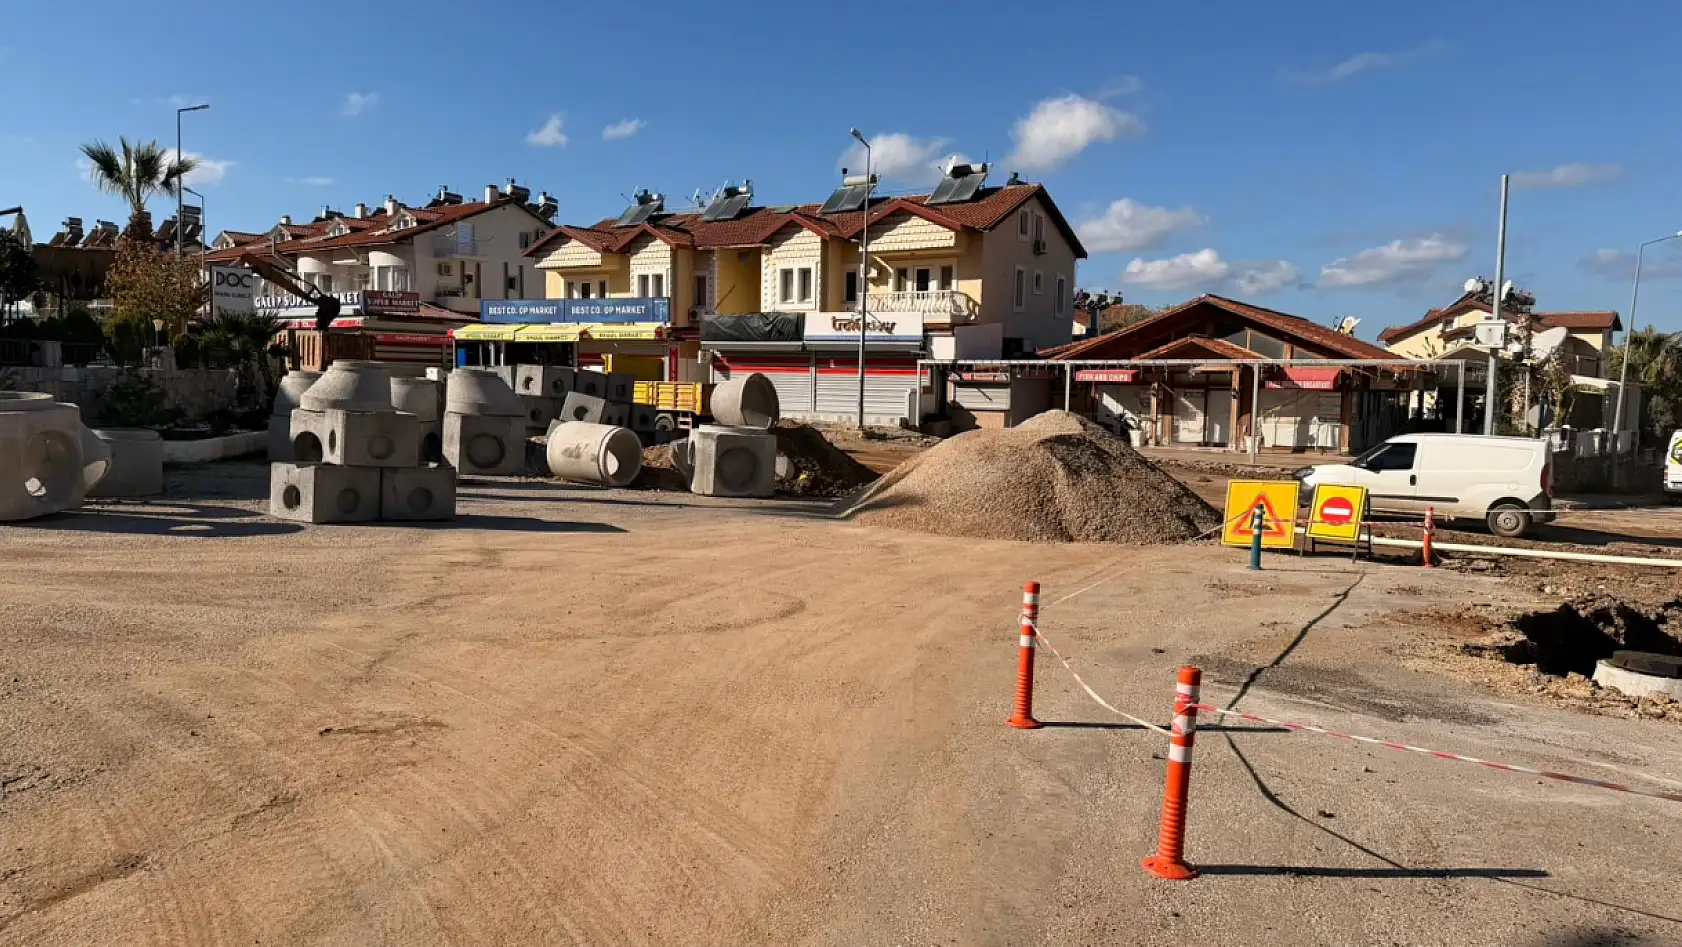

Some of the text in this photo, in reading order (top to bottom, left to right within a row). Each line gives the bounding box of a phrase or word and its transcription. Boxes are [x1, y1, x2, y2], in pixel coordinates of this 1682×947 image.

[215, 271, 252, 288] DOC
[488, 305, 505, 315] BEST
[528, 305, 558, 315] MARKET
[571, 305, 589, 315] BEST
[615, 306, 646, 314] MARKET
